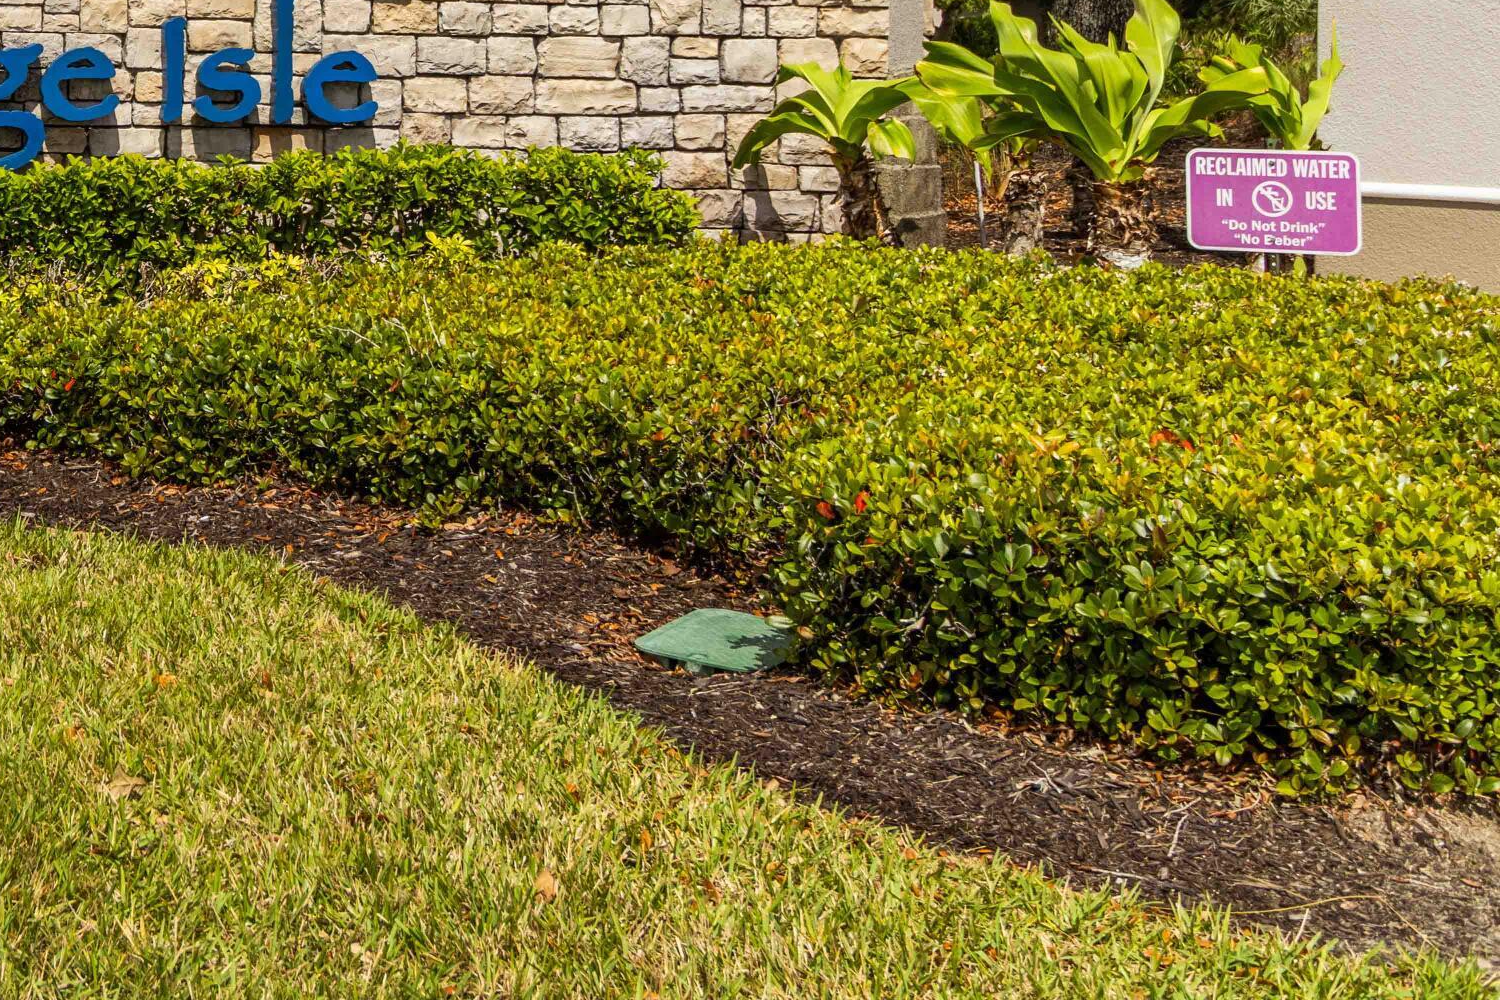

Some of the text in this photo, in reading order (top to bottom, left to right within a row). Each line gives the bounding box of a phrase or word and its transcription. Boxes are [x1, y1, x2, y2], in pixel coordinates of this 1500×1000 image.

[1195, 156, 1351, 179] RECLAIMED WATER
[1216, 188, 1338, 211] IN USE
[1221, 219, 1326, 234] “Do Not Drink”
[1234, 233, 1260, 245] “No
